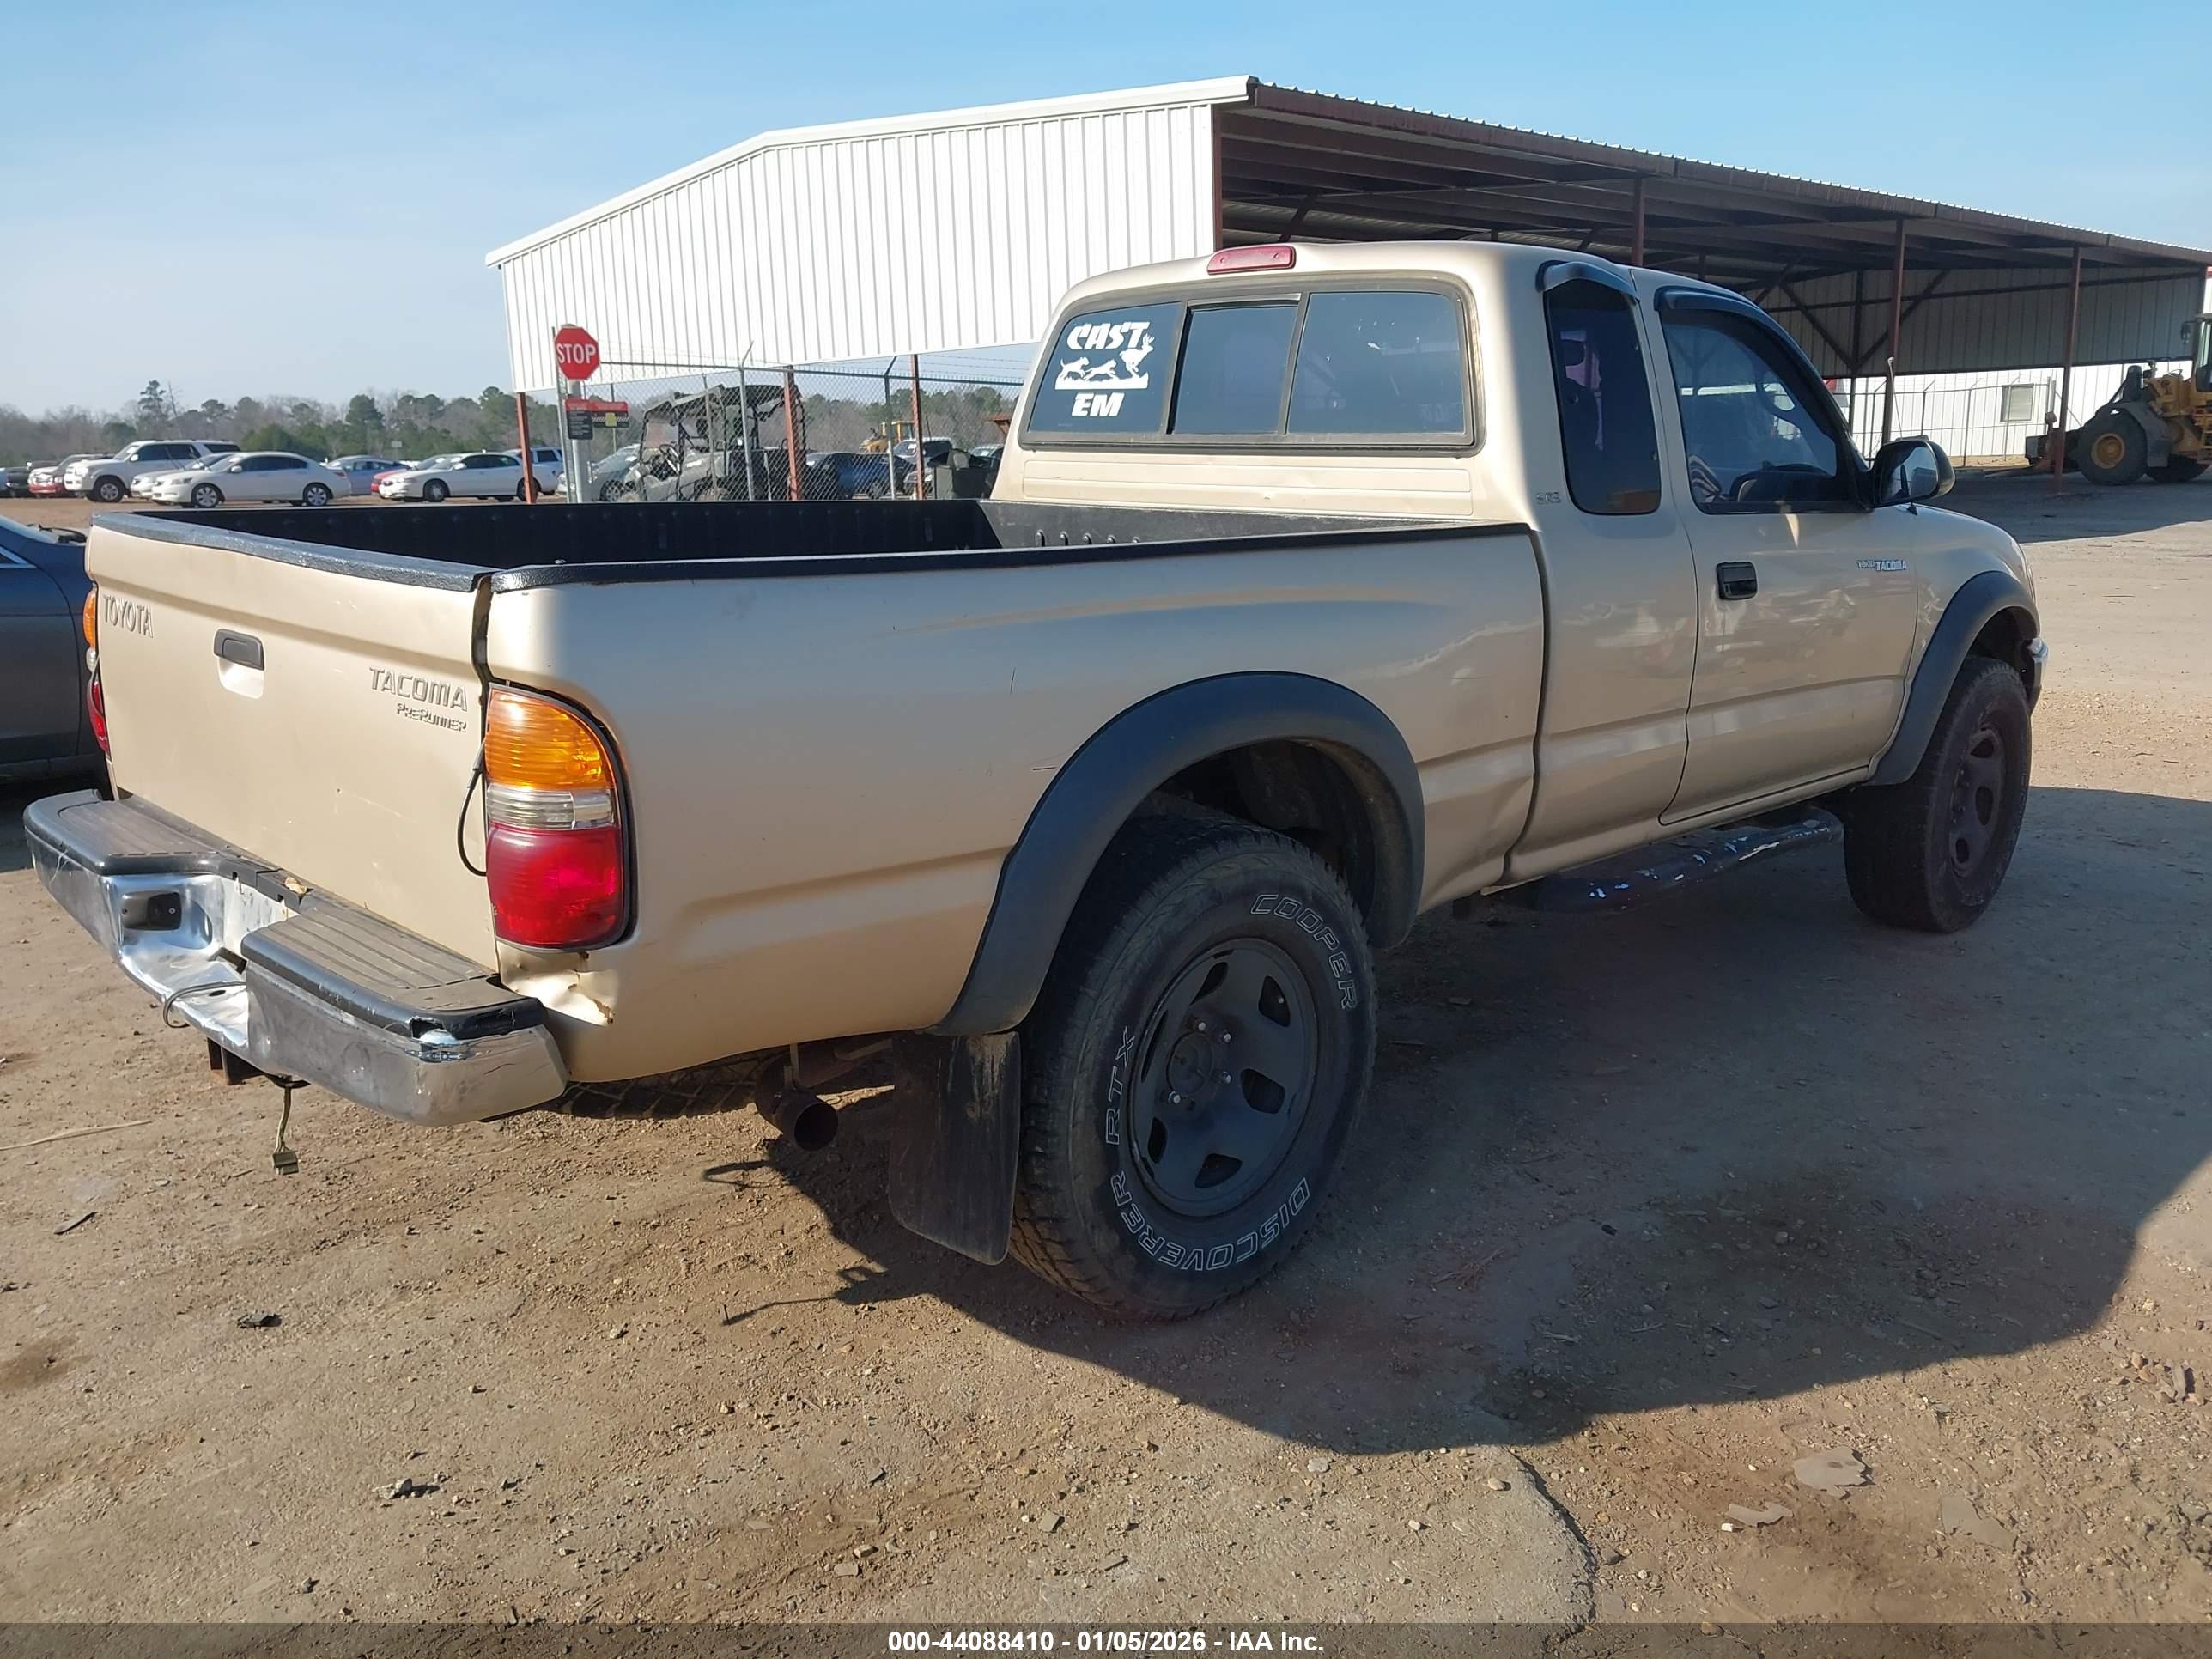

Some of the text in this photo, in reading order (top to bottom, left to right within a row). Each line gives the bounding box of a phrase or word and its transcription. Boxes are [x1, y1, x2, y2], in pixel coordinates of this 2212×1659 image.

[556, 343, 596, 364] STOP
[1066, 322, 1150, 350] CAST
[1071, 392, 1125, 416] EM
[103, 594, 154, 639] TOYOTA
[369, 667, 467, 712] TACOMA
[1250, 894, 1357, 1009] COOPER
[1106, 1026, 1310, 1271] DISCOVERER RTX
